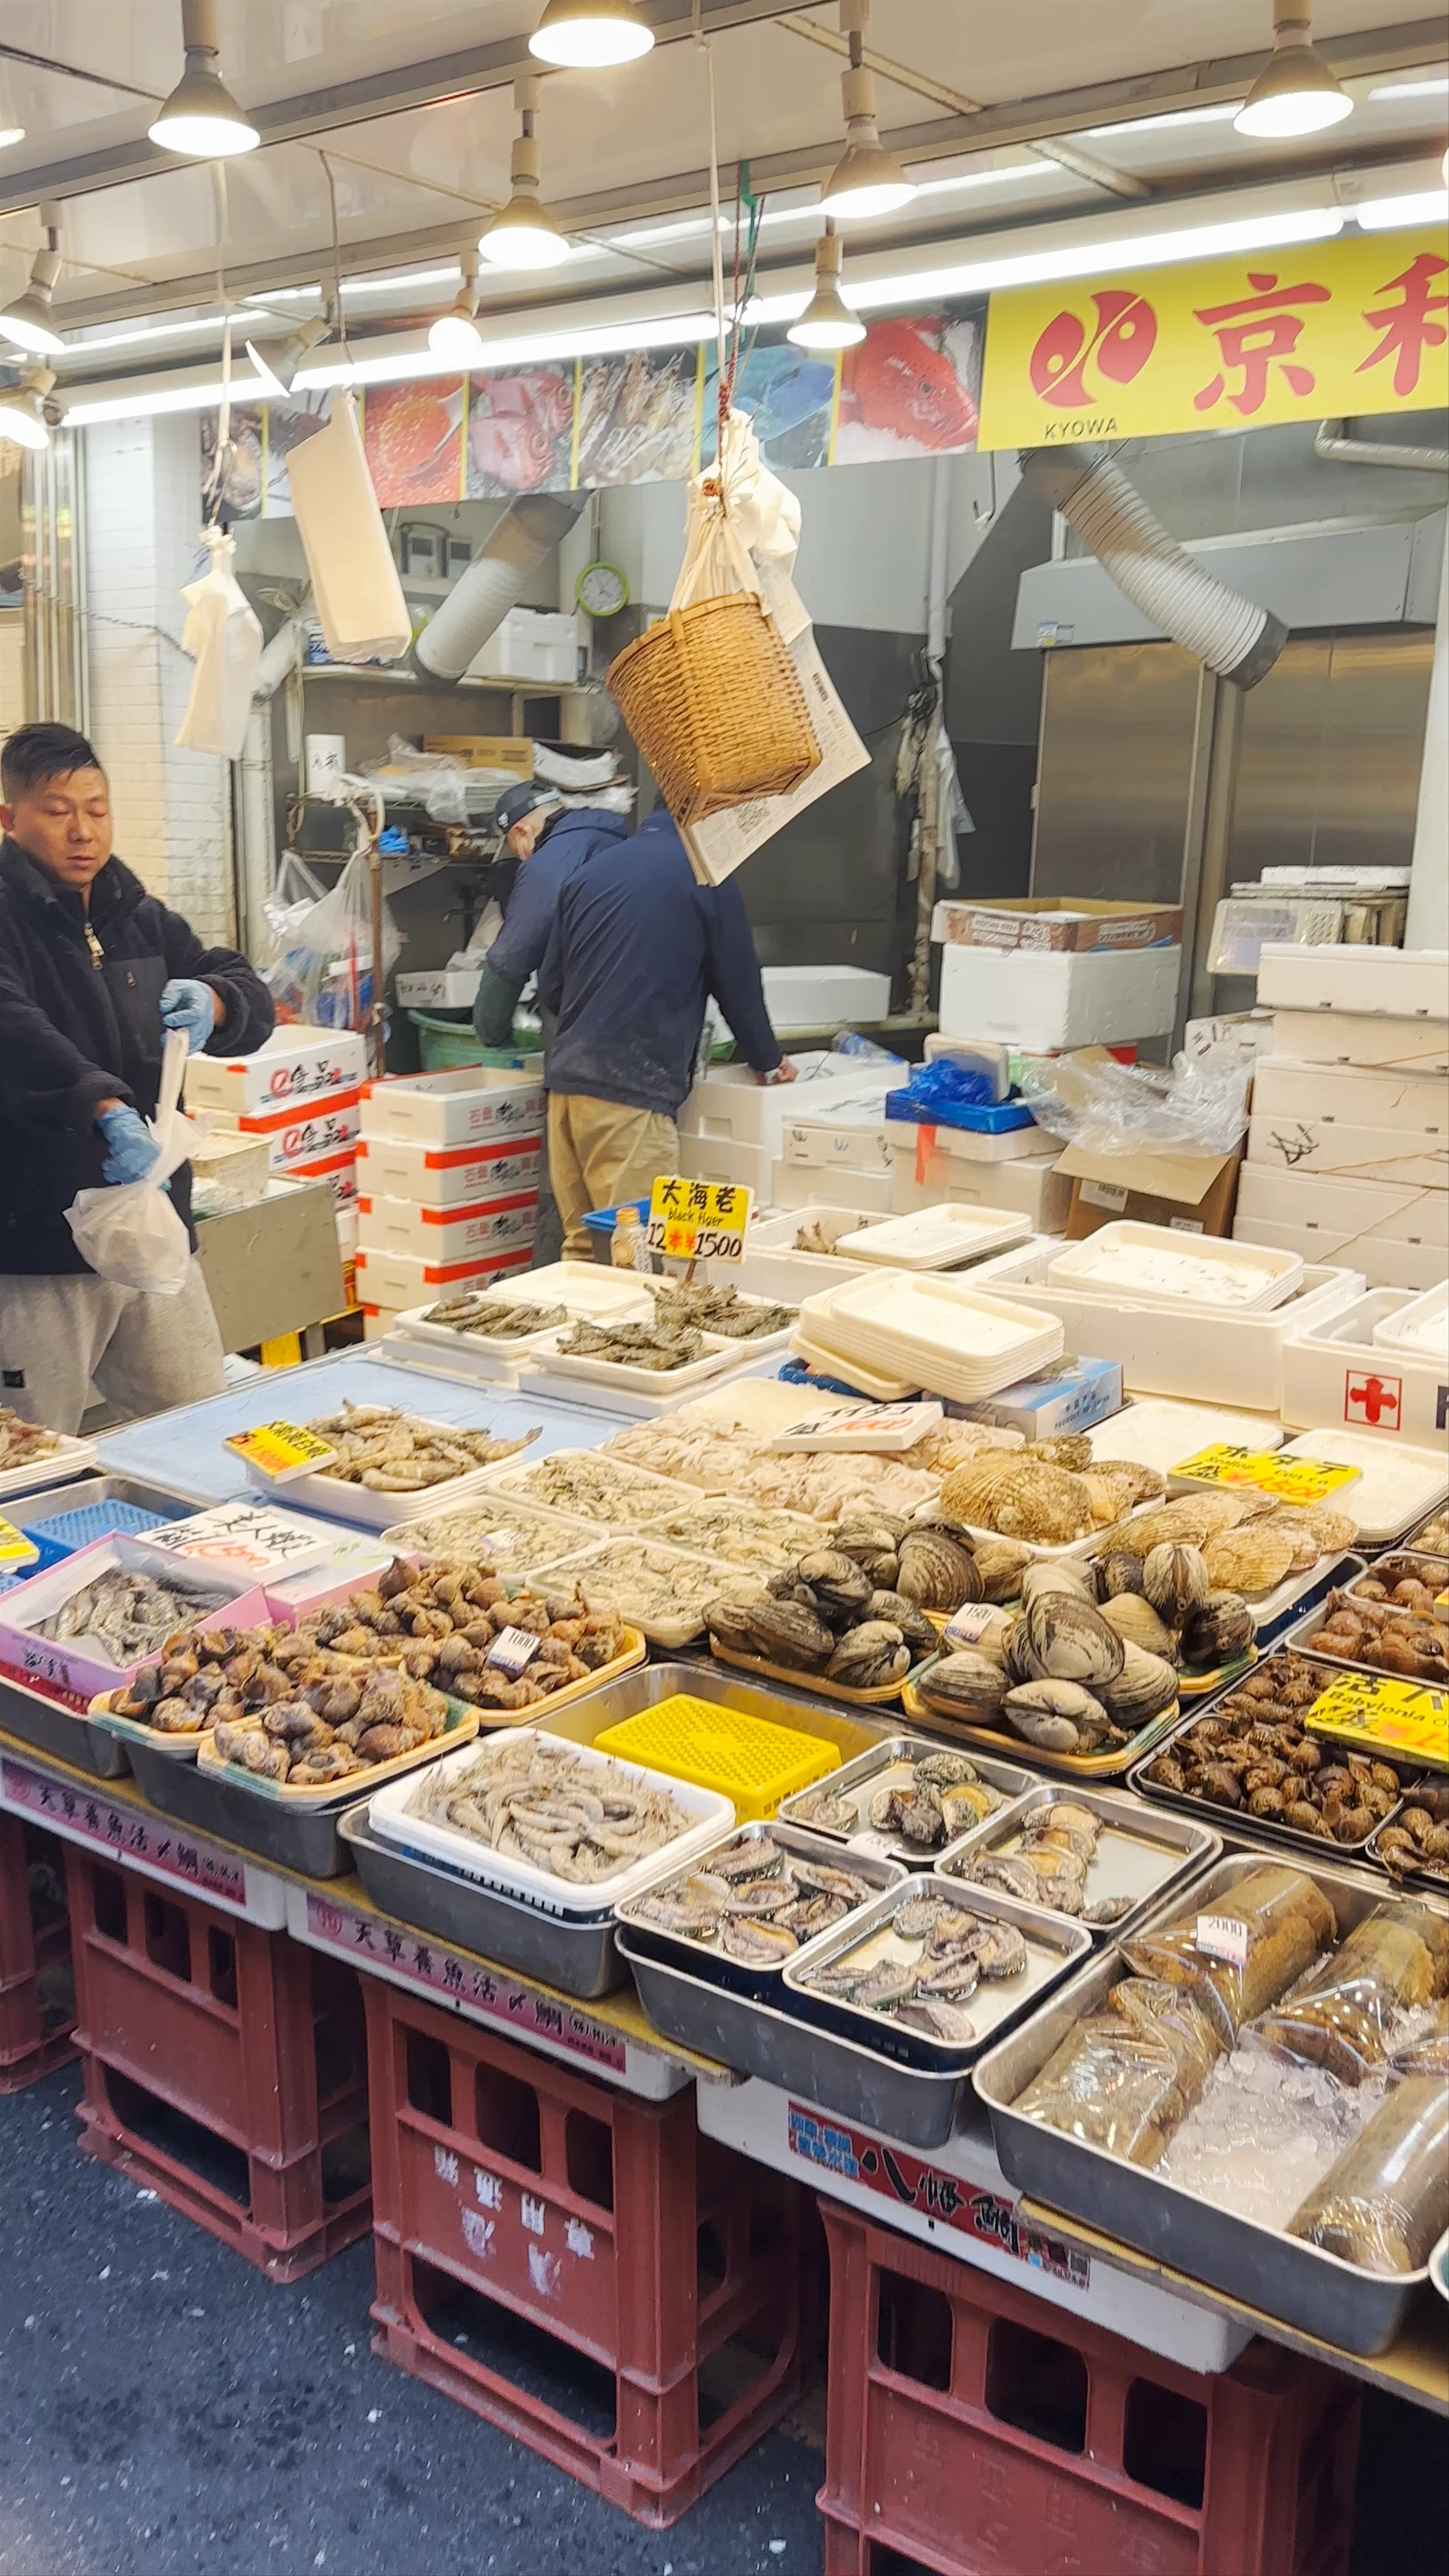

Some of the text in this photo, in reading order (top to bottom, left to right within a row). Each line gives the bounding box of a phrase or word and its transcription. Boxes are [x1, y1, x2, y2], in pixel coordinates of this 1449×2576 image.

[1044, 417, 1118, 440] KYOWA
[661, 1180, 736, 1213] 大海老
[668, 1207, 724, 1227] black tiger
[1218, 1446, 1351, 1475] ホタテ
[1328, 1691, 1426, 1722] Babylonia
[1208, 1916, 1242, 1938] 2000
